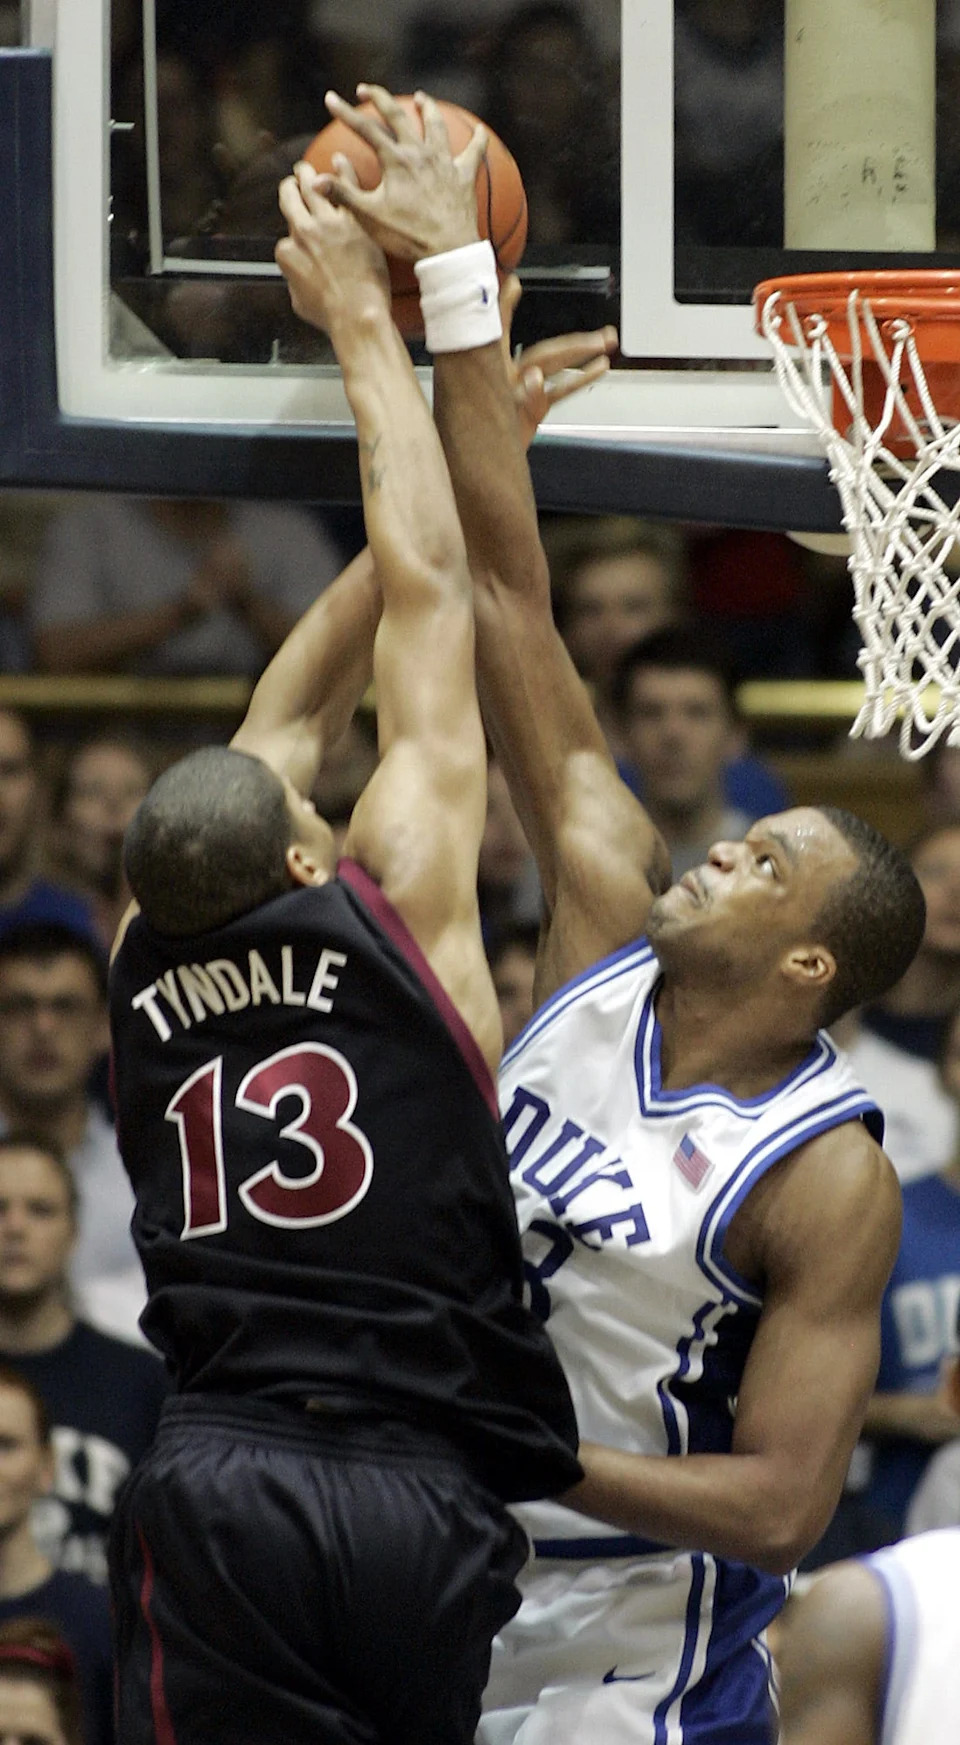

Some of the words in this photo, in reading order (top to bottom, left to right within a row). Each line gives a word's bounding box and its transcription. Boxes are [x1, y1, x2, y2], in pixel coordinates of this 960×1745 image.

[131, 945, 348, 1043] TYNDALE
[164, 1040, 375, 1242] 13
[502, 1085, 652, 1252] DUKE
